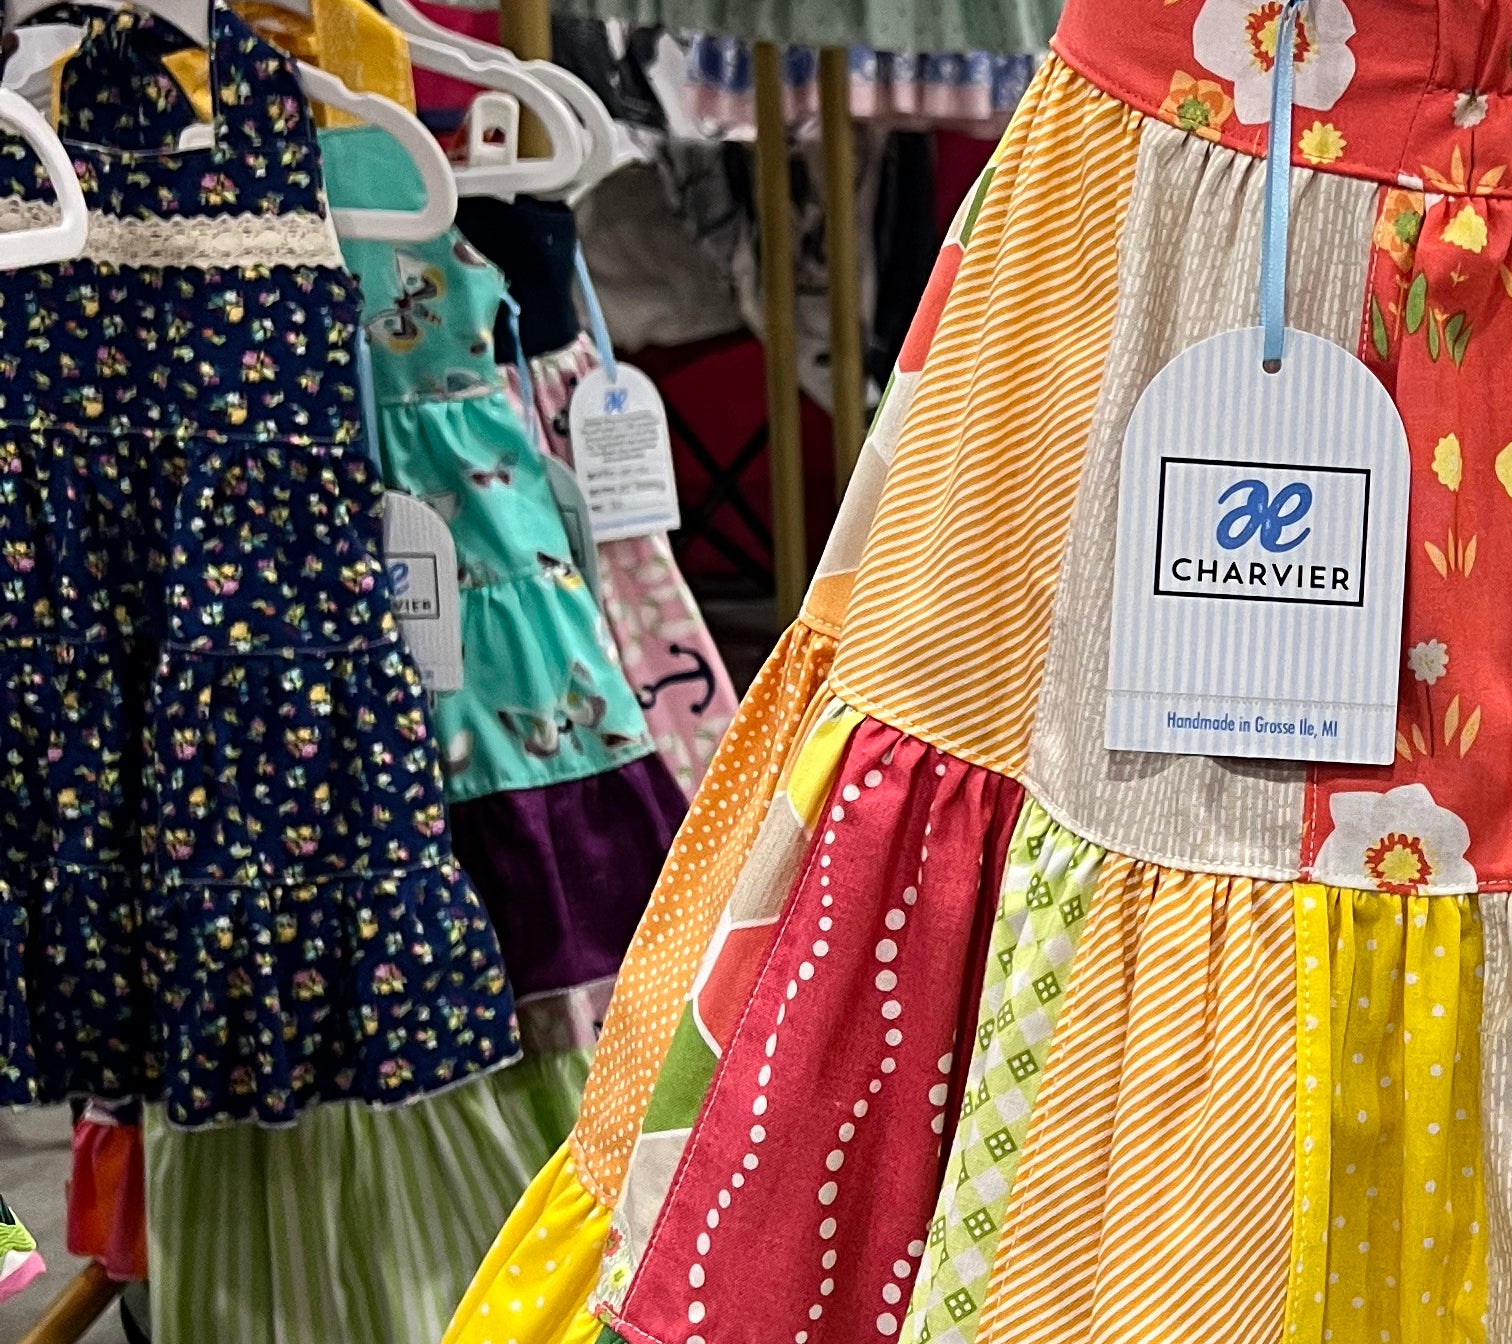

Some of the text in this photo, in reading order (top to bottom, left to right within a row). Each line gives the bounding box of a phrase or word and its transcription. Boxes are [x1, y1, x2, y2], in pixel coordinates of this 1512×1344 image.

[1172, 557, 1350, 591] CHARVIER
[1167, 711, 1338, 739] Handmade in Grosse Ile, MI
